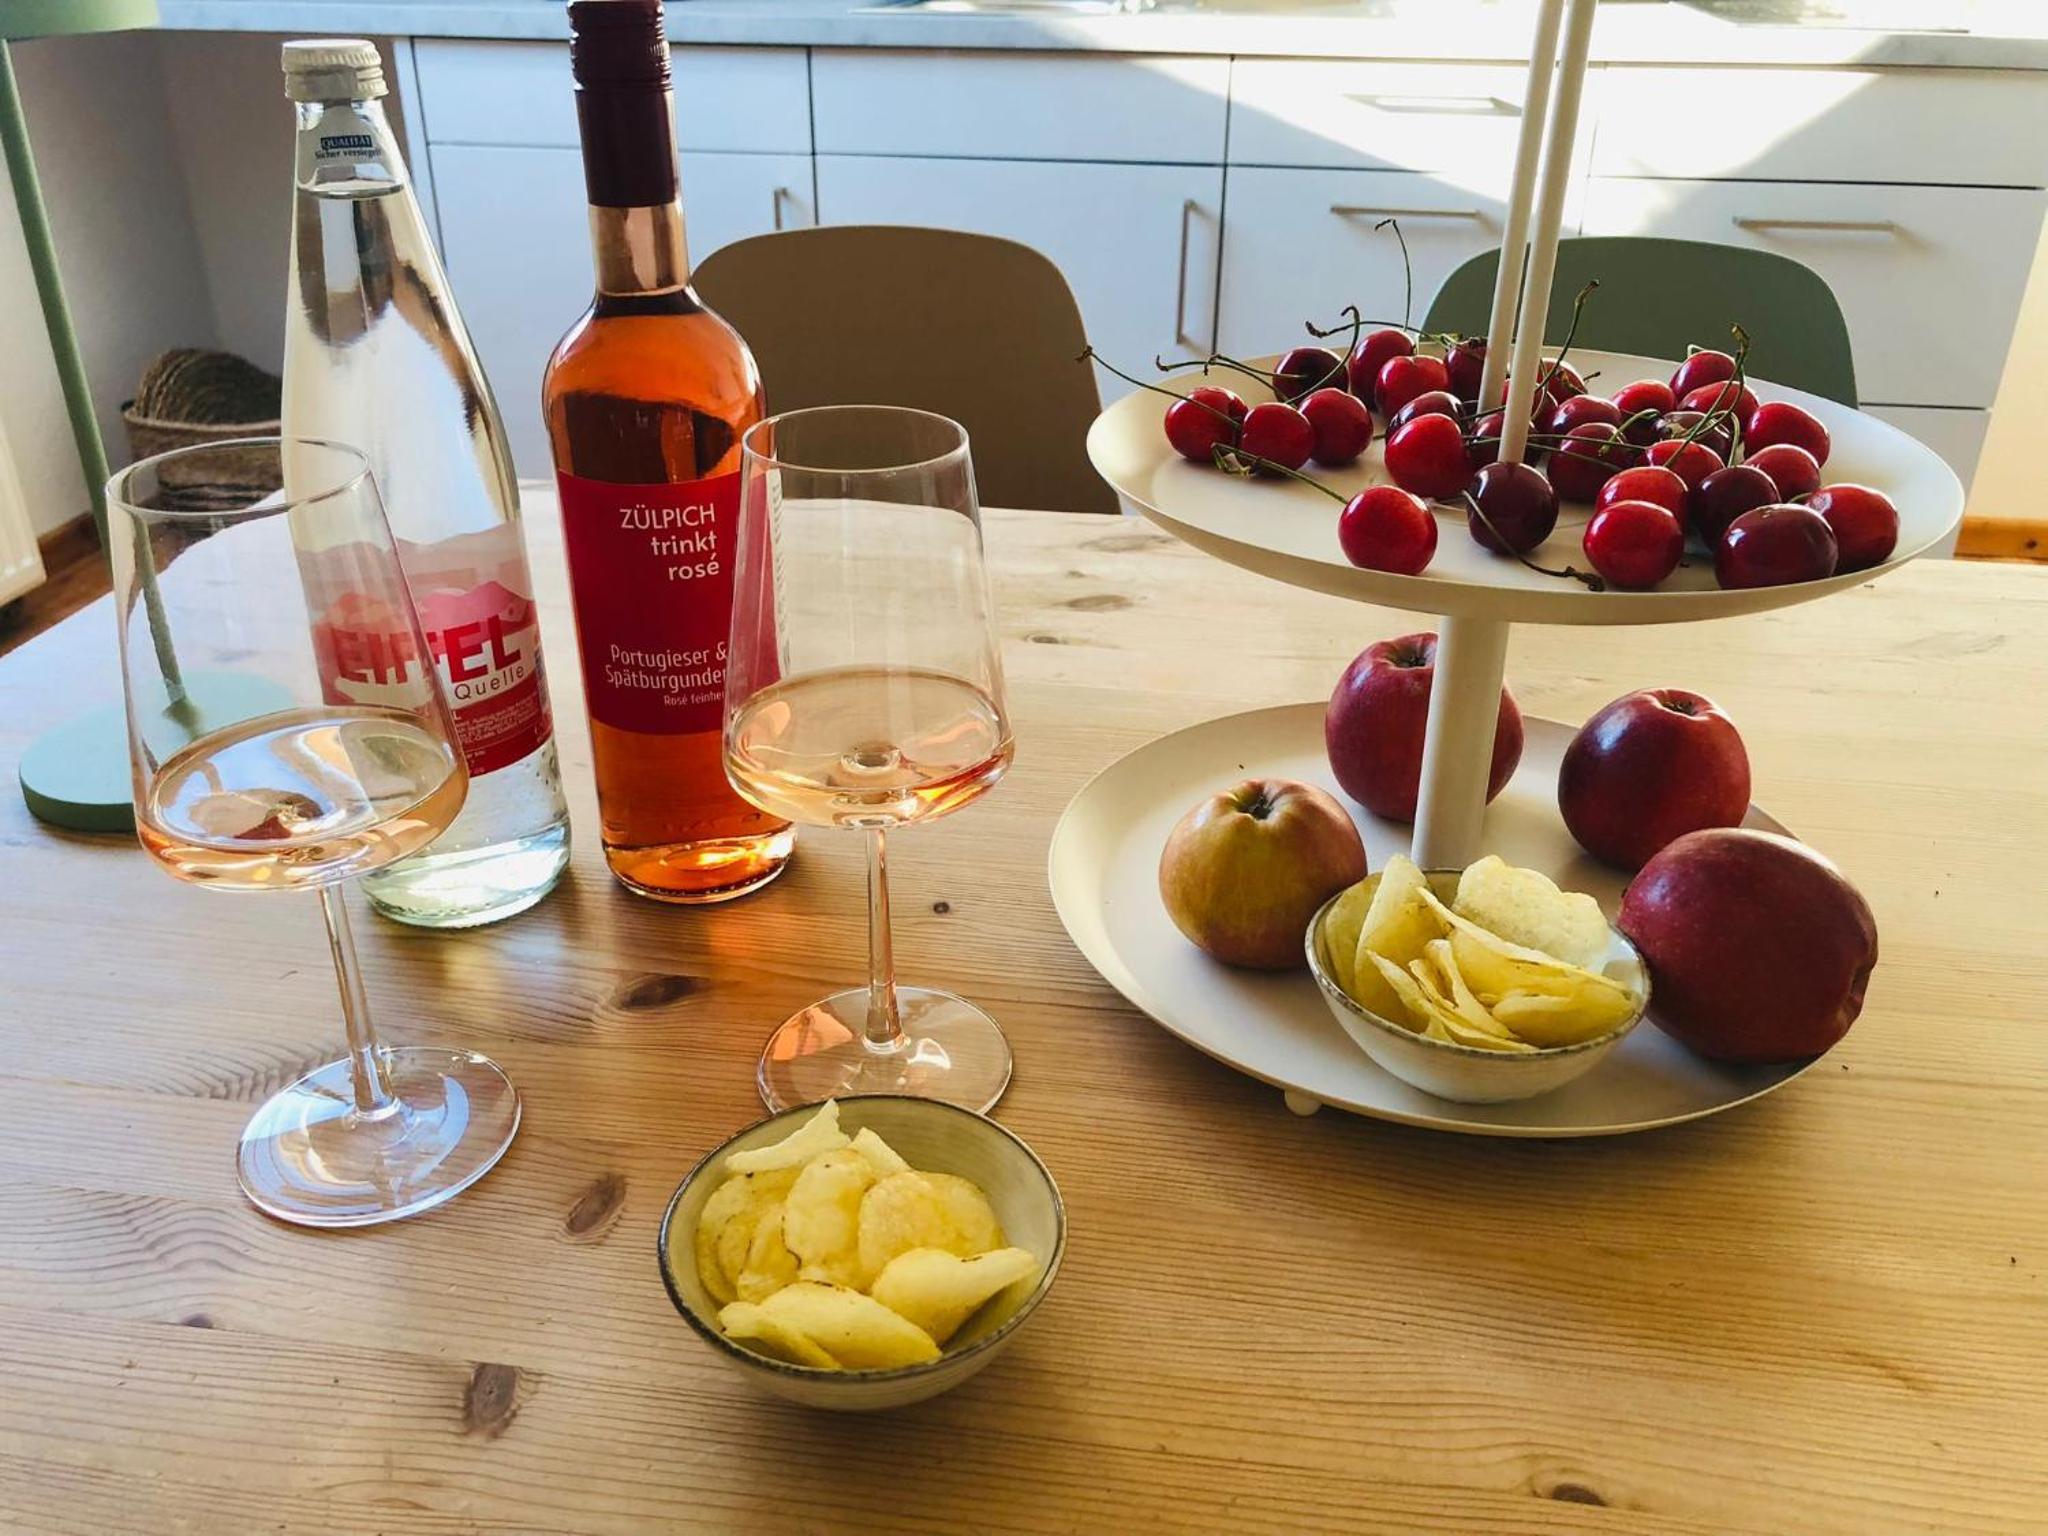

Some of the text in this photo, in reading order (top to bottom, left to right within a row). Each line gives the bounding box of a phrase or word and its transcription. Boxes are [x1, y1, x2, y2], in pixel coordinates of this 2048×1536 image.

[619, 503, 716, 530] ZÜLPICH
[651, 531, 718, 556] trinkt
[668, 554, 720, 581] rosé
[331, 615, 521, 684] EIFEL
[610, 641, 728, 672] Portugieser &
[454, 665, 525, 700] Quelle
[605, 664, 727, 693] Spätburgunder
[663, 690, 726, 706] Rosé feinher
